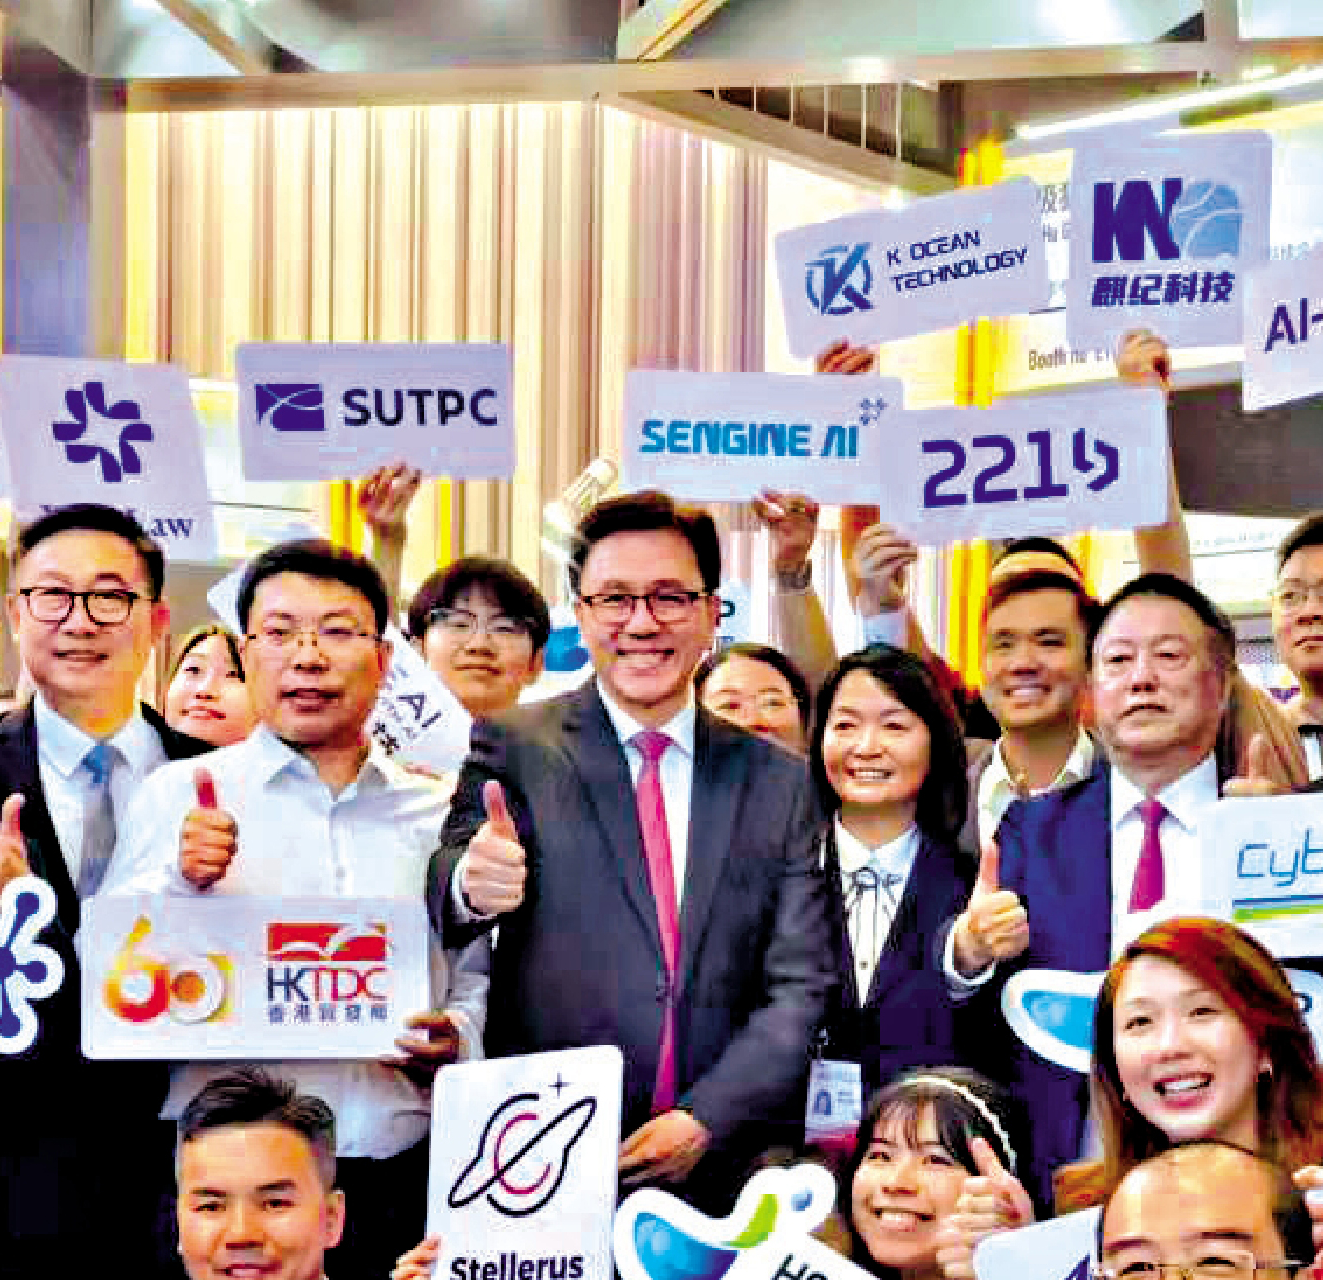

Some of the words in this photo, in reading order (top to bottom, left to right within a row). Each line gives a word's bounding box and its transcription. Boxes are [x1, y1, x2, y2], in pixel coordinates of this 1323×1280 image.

[886, 248, 903, 267] K
[908, 230, 981, 261] OCEAN
[889, 246, 1029, 293] TECHNOLOGY
[342, 386, 499, 429] SUTPC
[641, 418, 810, 459] SENGINE
[820, 419, 858, 459] AI
[267, 967, 390, 1002] HKTDC
